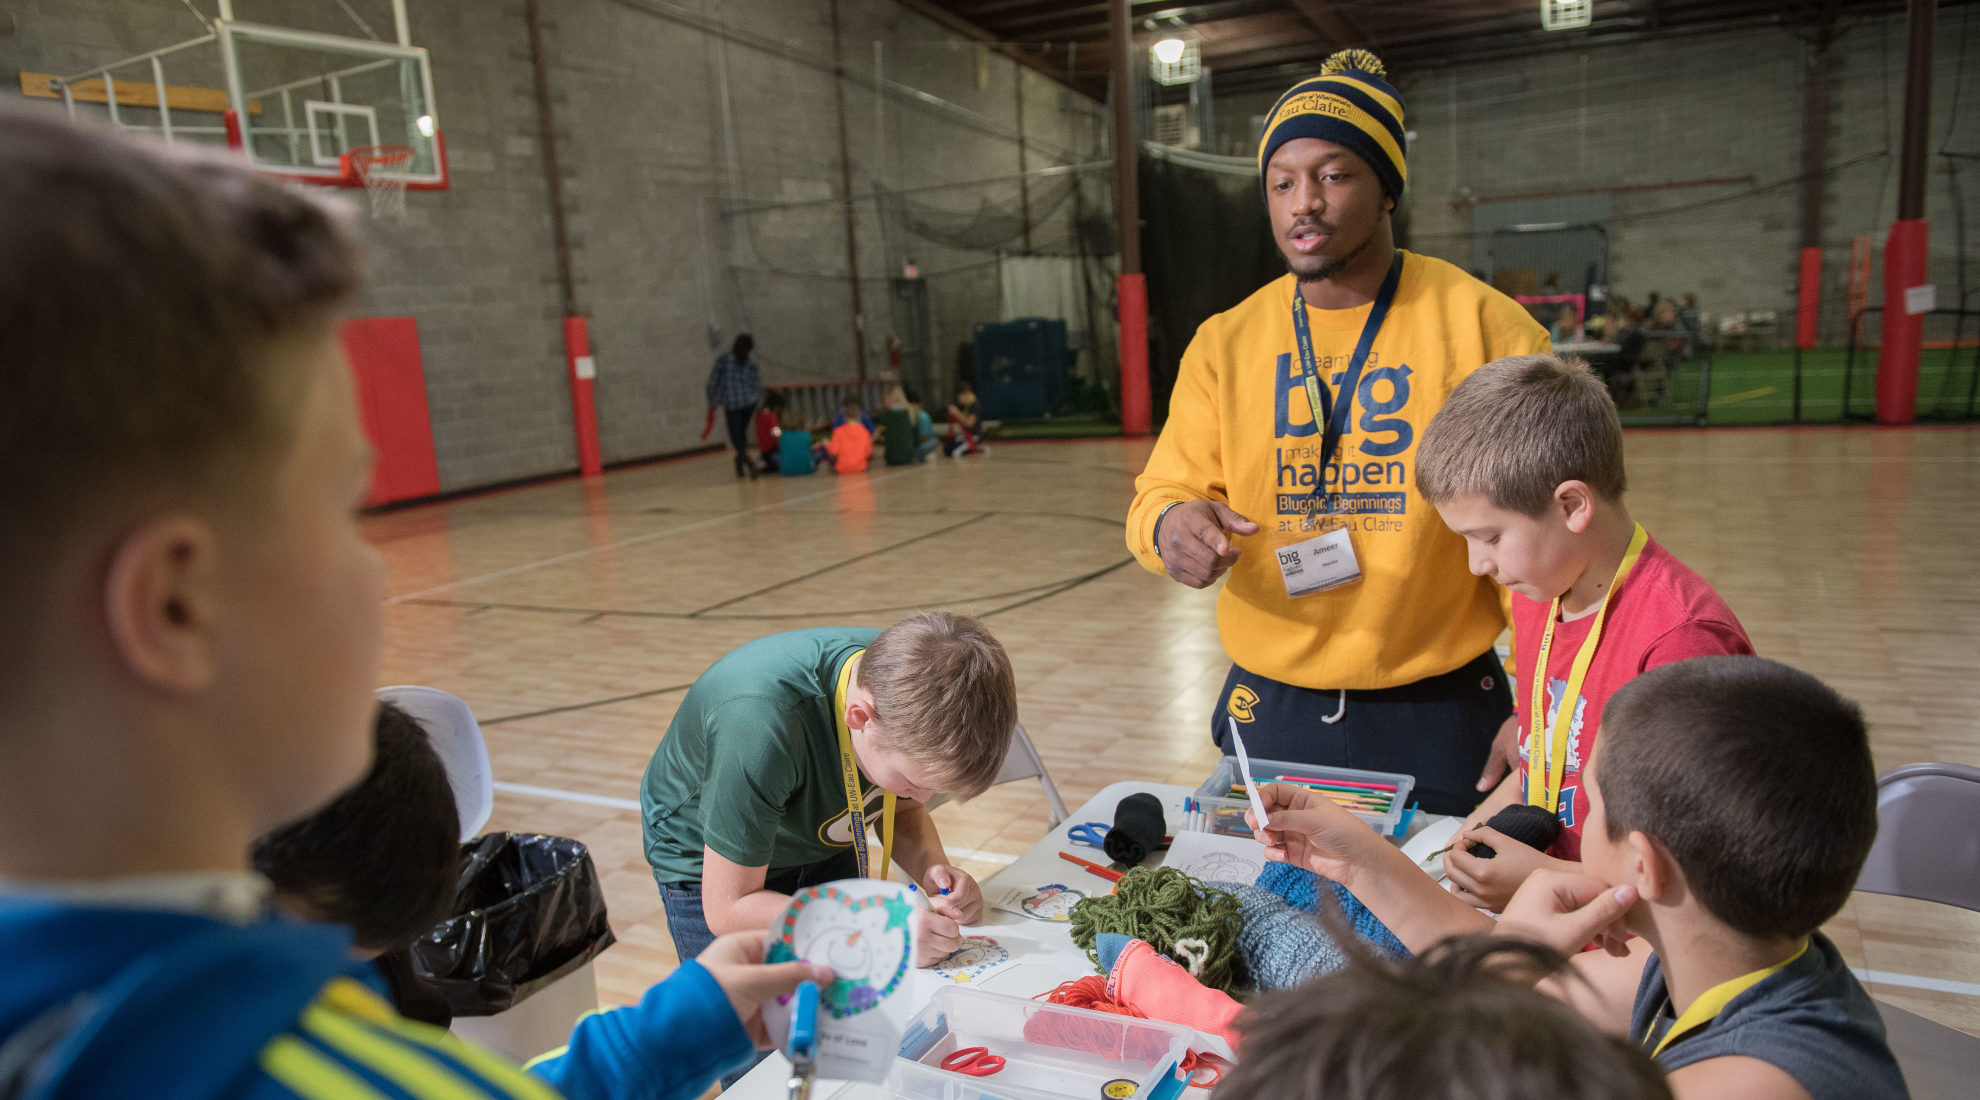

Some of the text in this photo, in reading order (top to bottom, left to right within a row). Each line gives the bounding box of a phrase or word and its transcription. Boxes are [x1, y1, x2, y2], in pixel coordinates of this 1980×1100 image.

[1303, 99, 1347, 118] Claire
[1293, 350, 1379, 370] deamg
[1285, 444, 1356, 461] makg it
[1277, 447, 1405, 493] happen
[1279, 495, 1402, 513] Blugold Beginnings
[1278, 519, 1291, 531] at
[1363, 516, 1404, 532] Claire
[1278, 543, 1339, 565] big Ameer
[843, 753, 853, 773] Claire
[1532, 750, 1541, 771] Claire
[847, 773, 858, 803] UW-Eau
[853, 811, 866, 852] Beginnings
